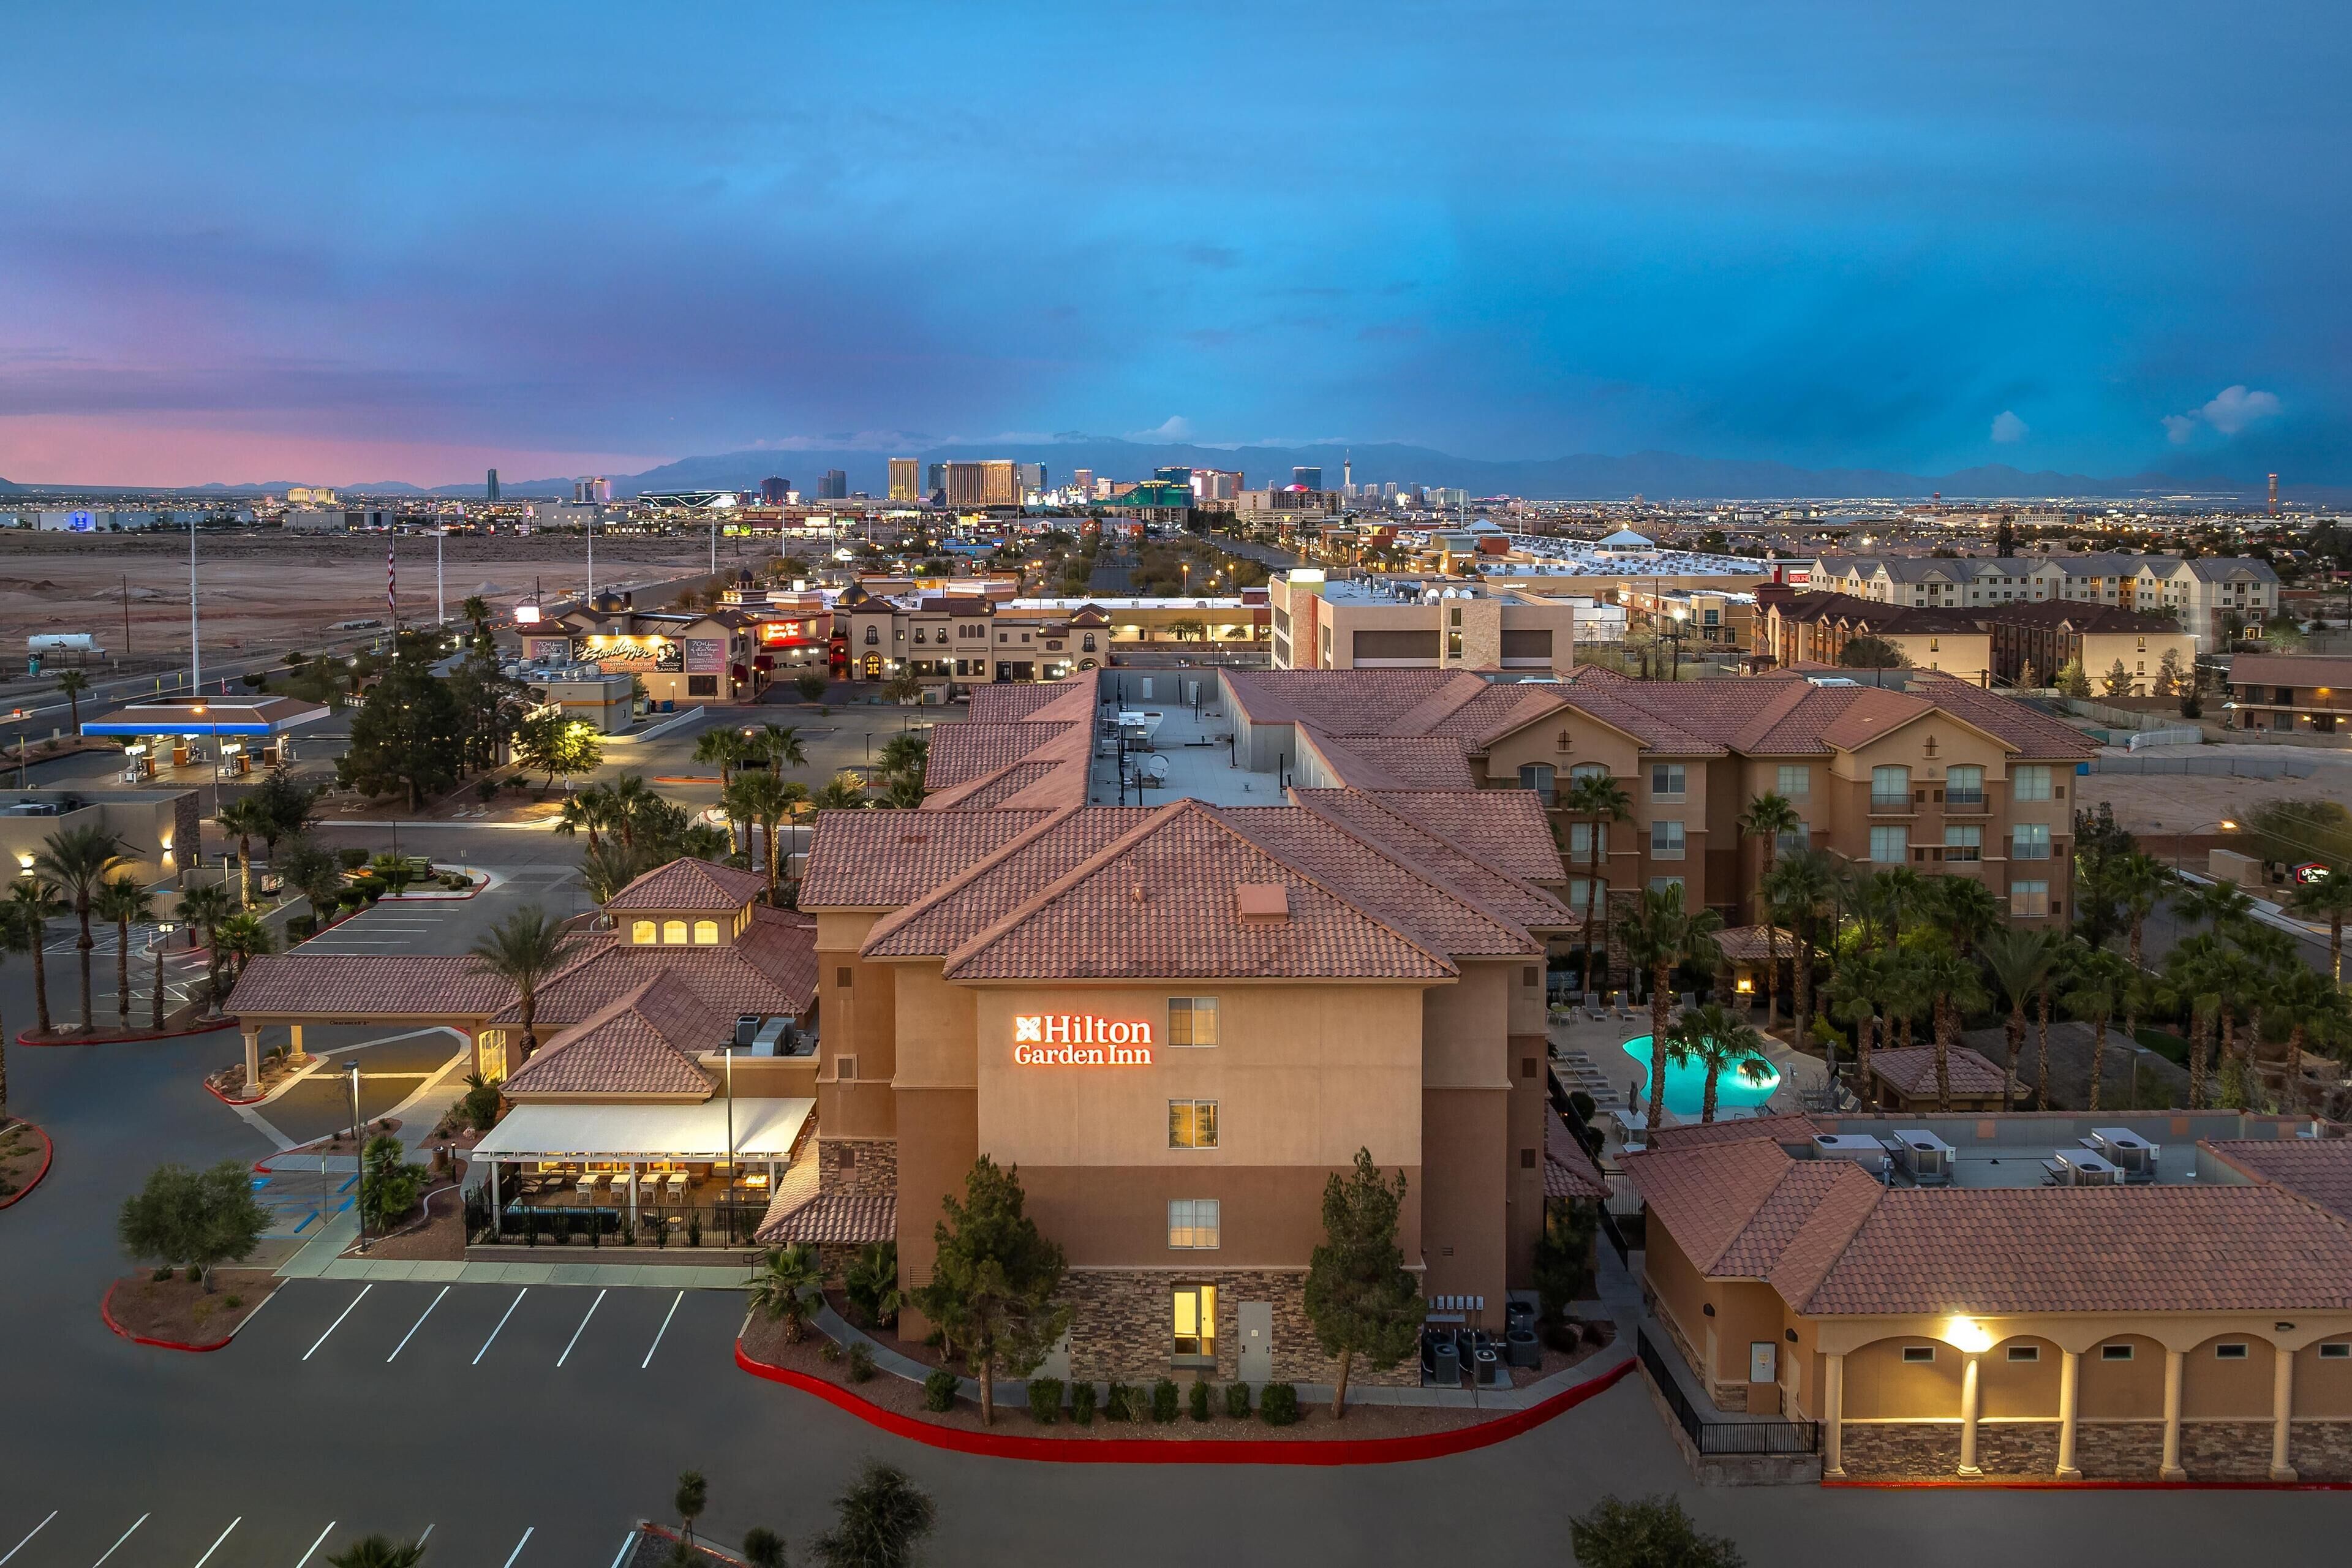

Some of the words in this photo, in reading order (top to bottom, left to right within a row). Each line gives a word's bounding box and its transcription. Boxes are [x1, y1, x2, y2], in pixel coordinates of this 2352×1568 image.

[575, 643, 584, 652] the
[576, 639, 655, 661] Bootlegger
[1044, 1015, 1152, 1043] Hilton
[1014, 1044, 1105, 1065] Garden
[1107, 1044, 1152, 1065] Inn
